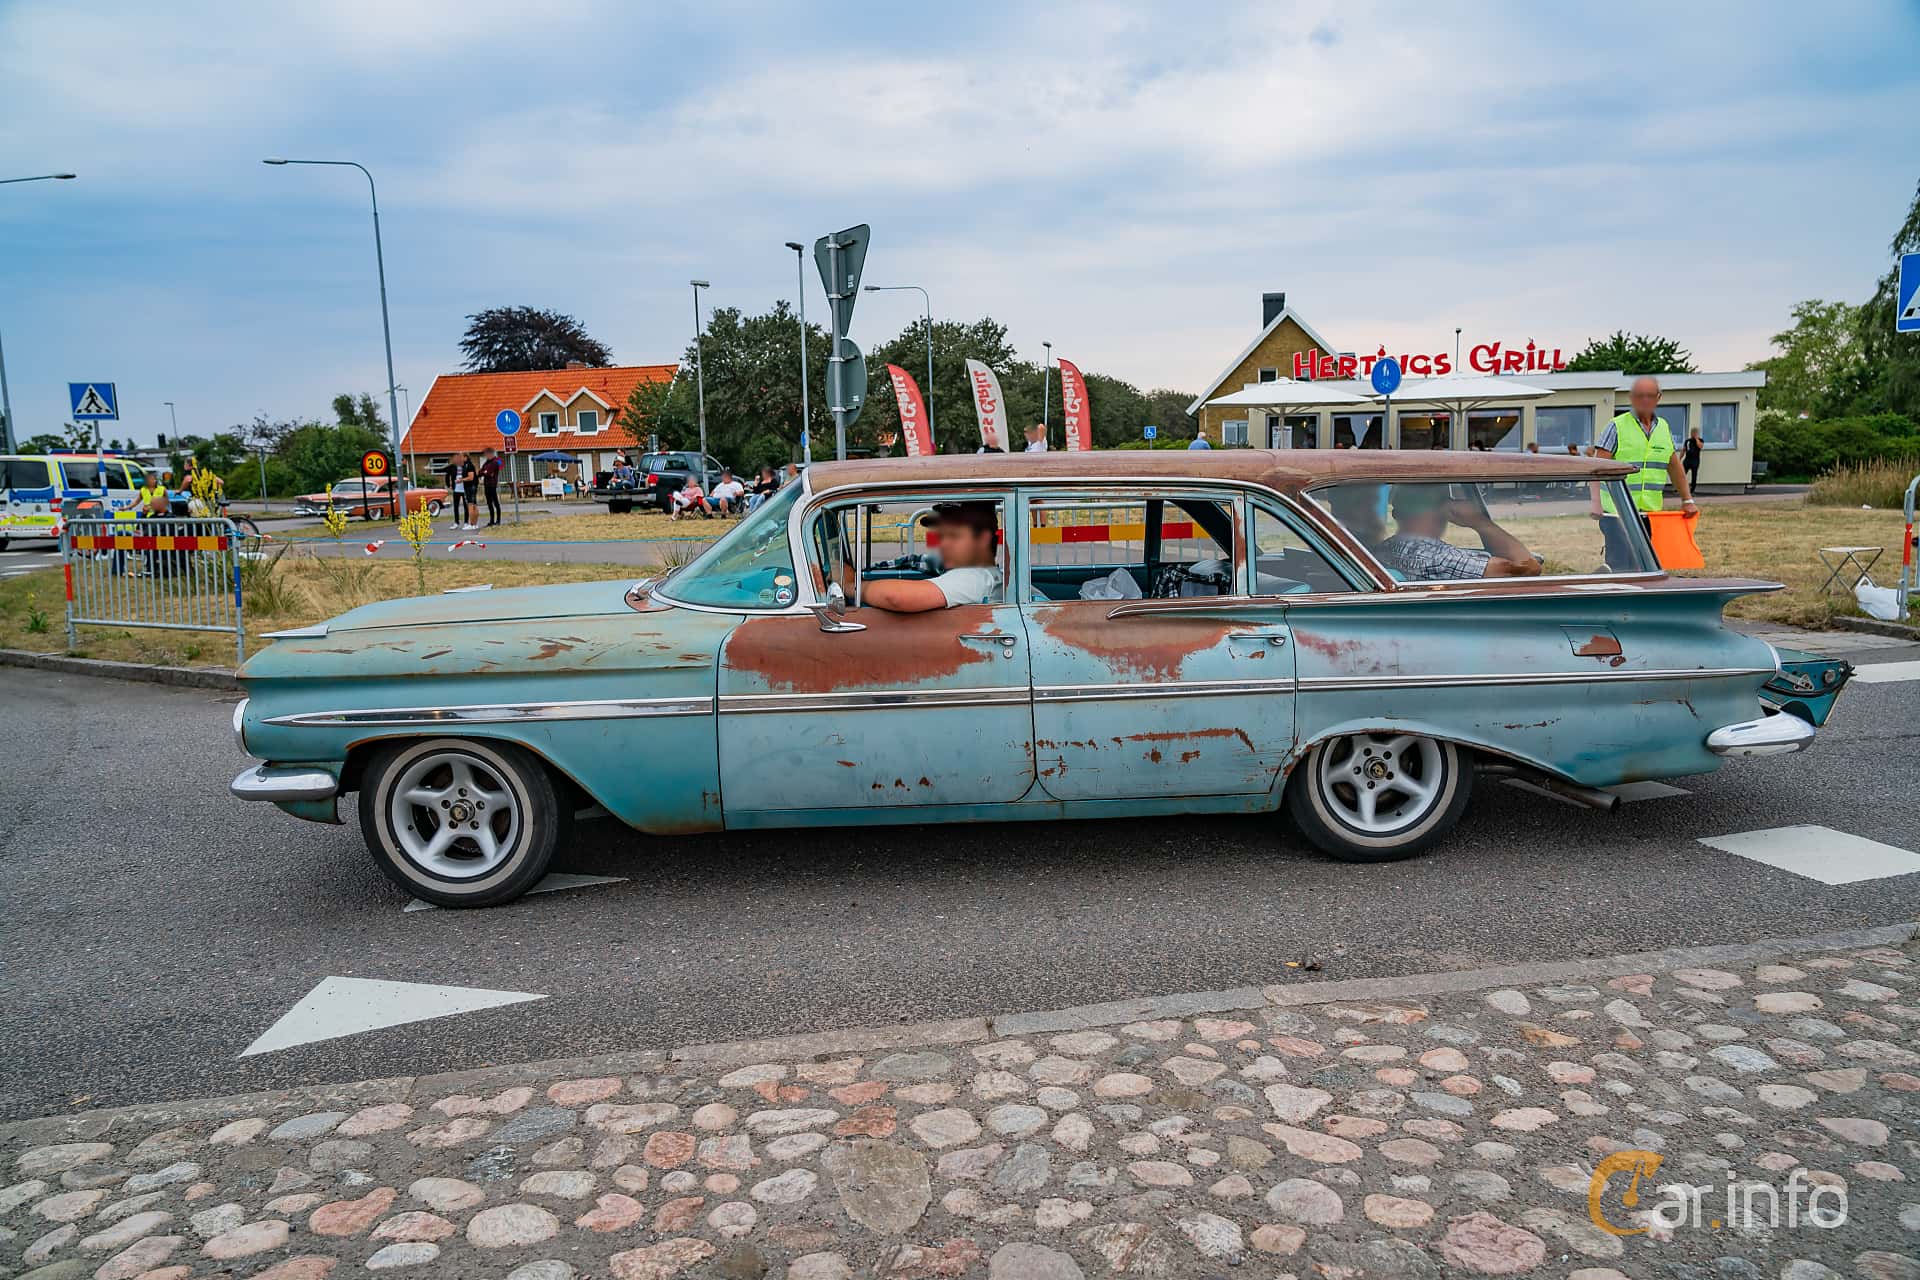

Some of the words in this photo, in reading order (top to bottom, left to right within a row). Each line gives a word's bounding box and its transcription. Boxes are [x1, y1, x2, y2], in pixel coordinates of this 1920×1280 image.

[1293, 344, 1452, 381] HERTNGS
[1469, 337, 1566, 376] GRILL
[368, 458, 384, 470] 30
